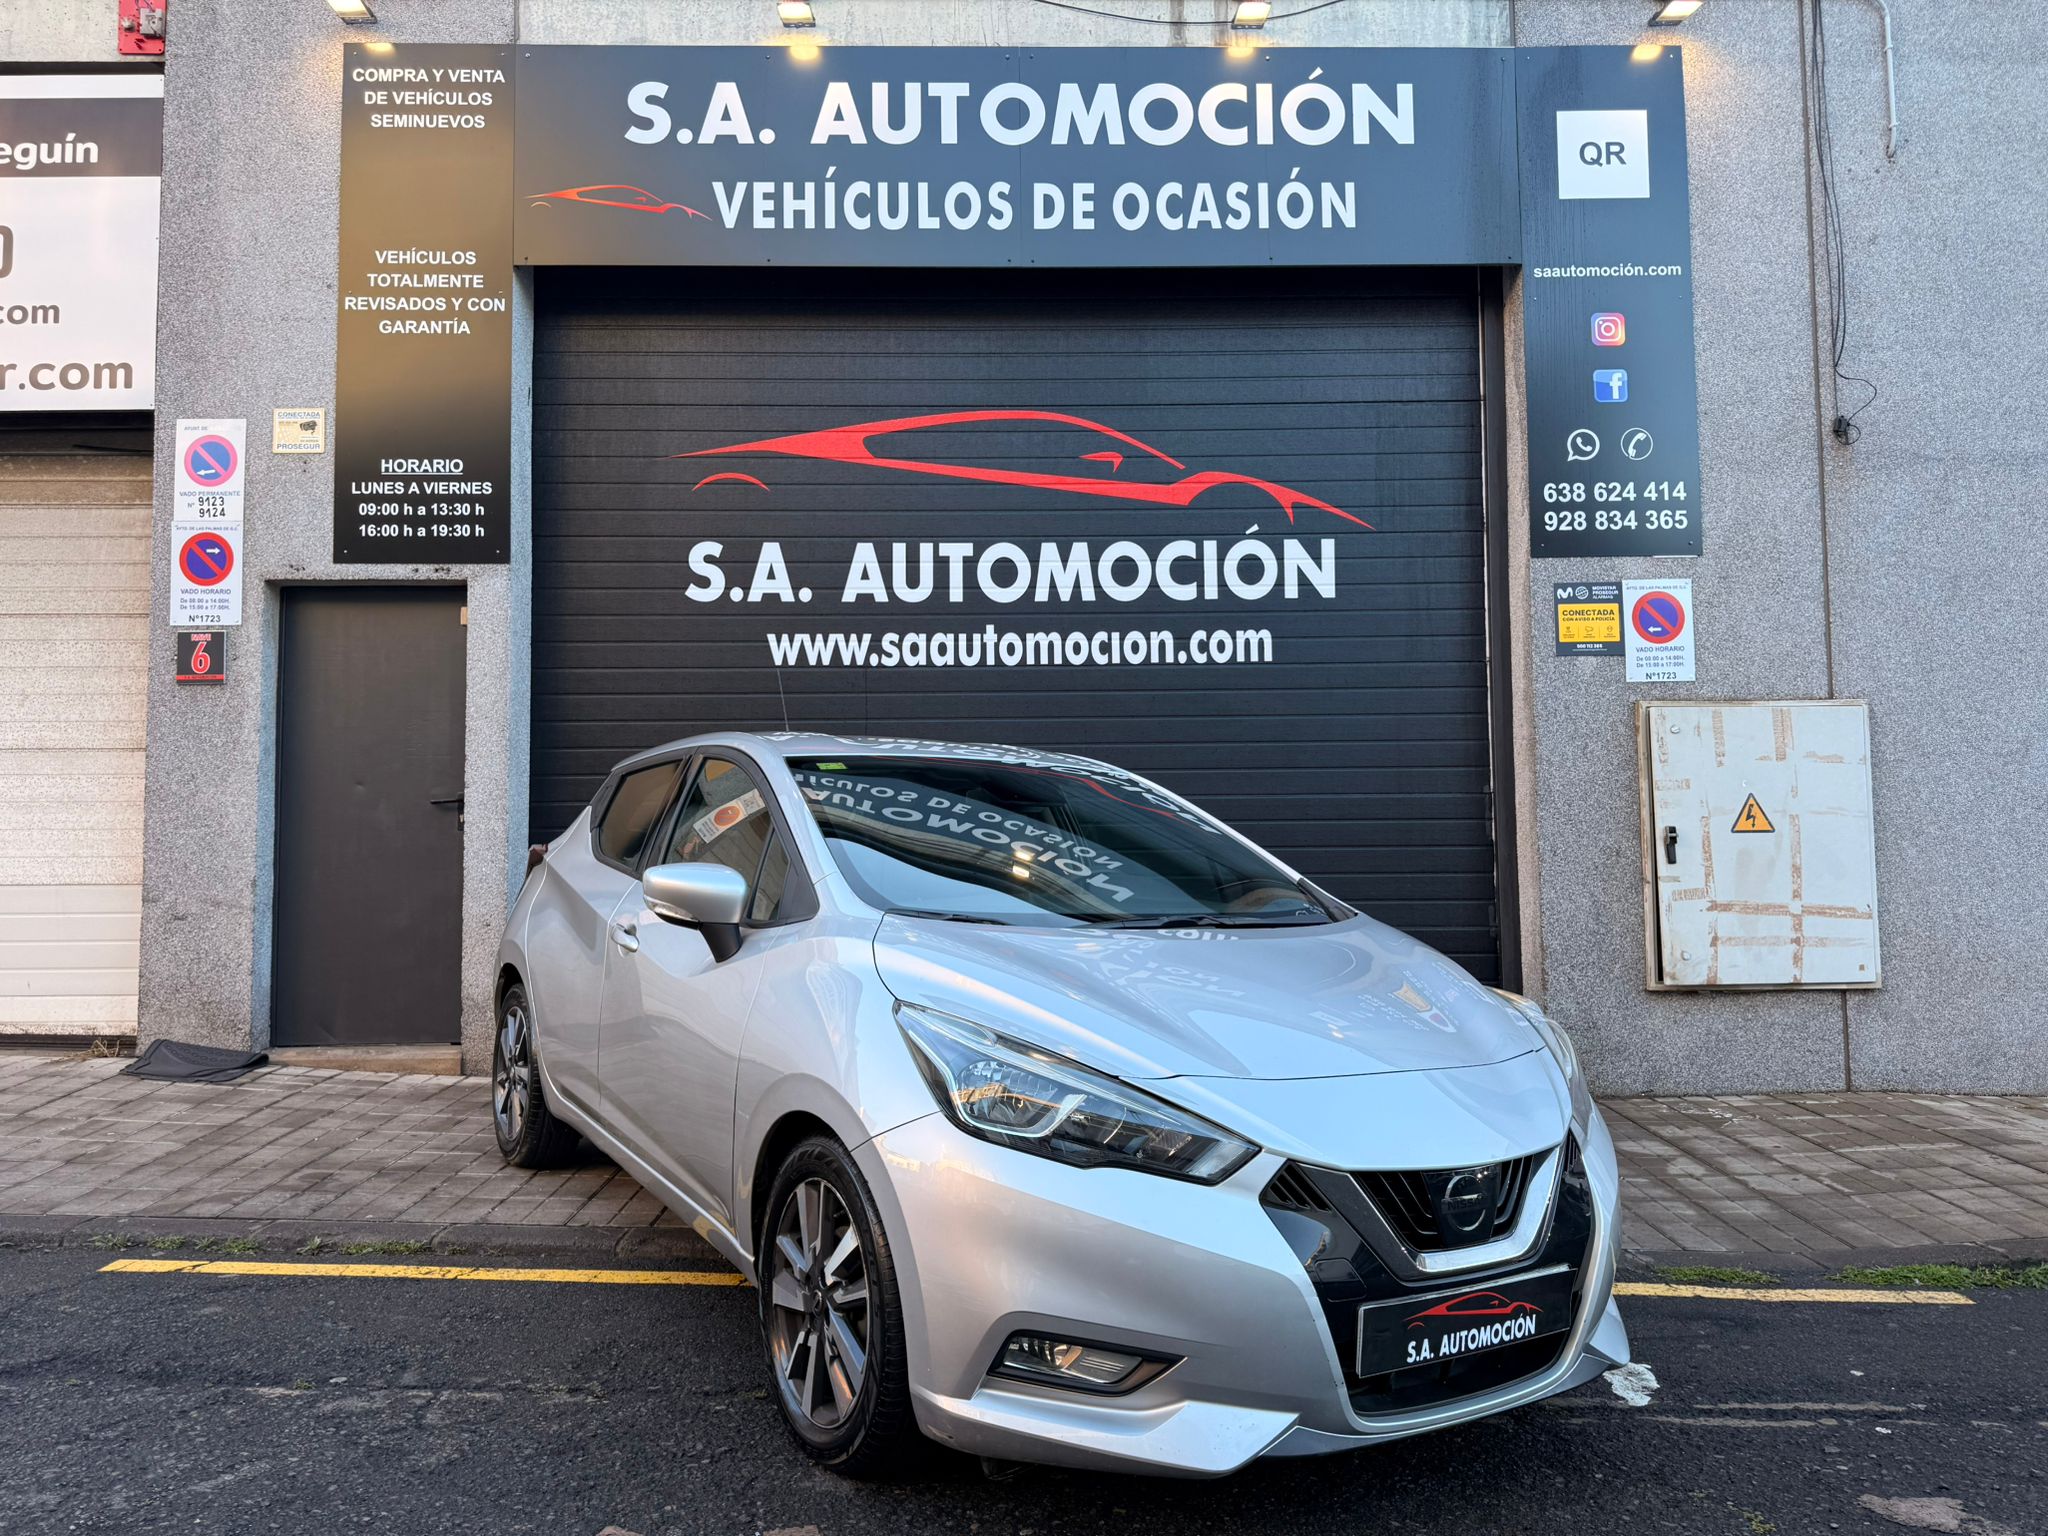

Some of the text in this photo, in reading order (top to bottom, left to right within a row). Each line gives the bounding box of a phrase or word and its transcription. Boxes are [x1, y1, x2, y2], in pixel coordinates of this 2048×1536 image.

[353, 69, 505, 83] COMPRA Y VENTA
[364, 89, 493, 106] DE VEHÍCULOS
[624, 67, 1415, 146] S.A. AUTOMOCIÓN
[370, 114, 485, 128] SEMINUEVOS
[1579, 141, 1626, 167] QR
[711, 166, 1357, 231] VEHÍCULOS DE OCASIÓN
[375, 247, 477, 265] VEHÍCULOS
[1533, 263, 1682, 278] saautomoción.com
[367, 274, 484, 288] TOTALMENTE
[345, 296, 506, 311] REVISADOS Y CON
[0, 304, 60, 325] om
[379, 317, 470, 334] GARANTÍA
[381, 458, 464, 474] HORARIO
[351, 482, 492, 495] LUNES A VIERNES
[1543, 481, 1687, 503] 638 624 414
[198, 496, 225, 507] 9123
[358, 503, 485, 516] 09:00 h a 13:30 h
[199, 507, 226, 518] 9124
[1544, 510, 1688, 531] 928 834 365
[359, 524, 485, 537] 16:00 h a 19:30 h
[685, 524, 1336, 603] S.A. AUTOMOCIÓN
[767, 624, 1272, 667] www.saautomocion.com
[191, 641, 210, 674] 6
[1407, 1313, 1536, 1363] S.A. AUTOMOCIÓN
